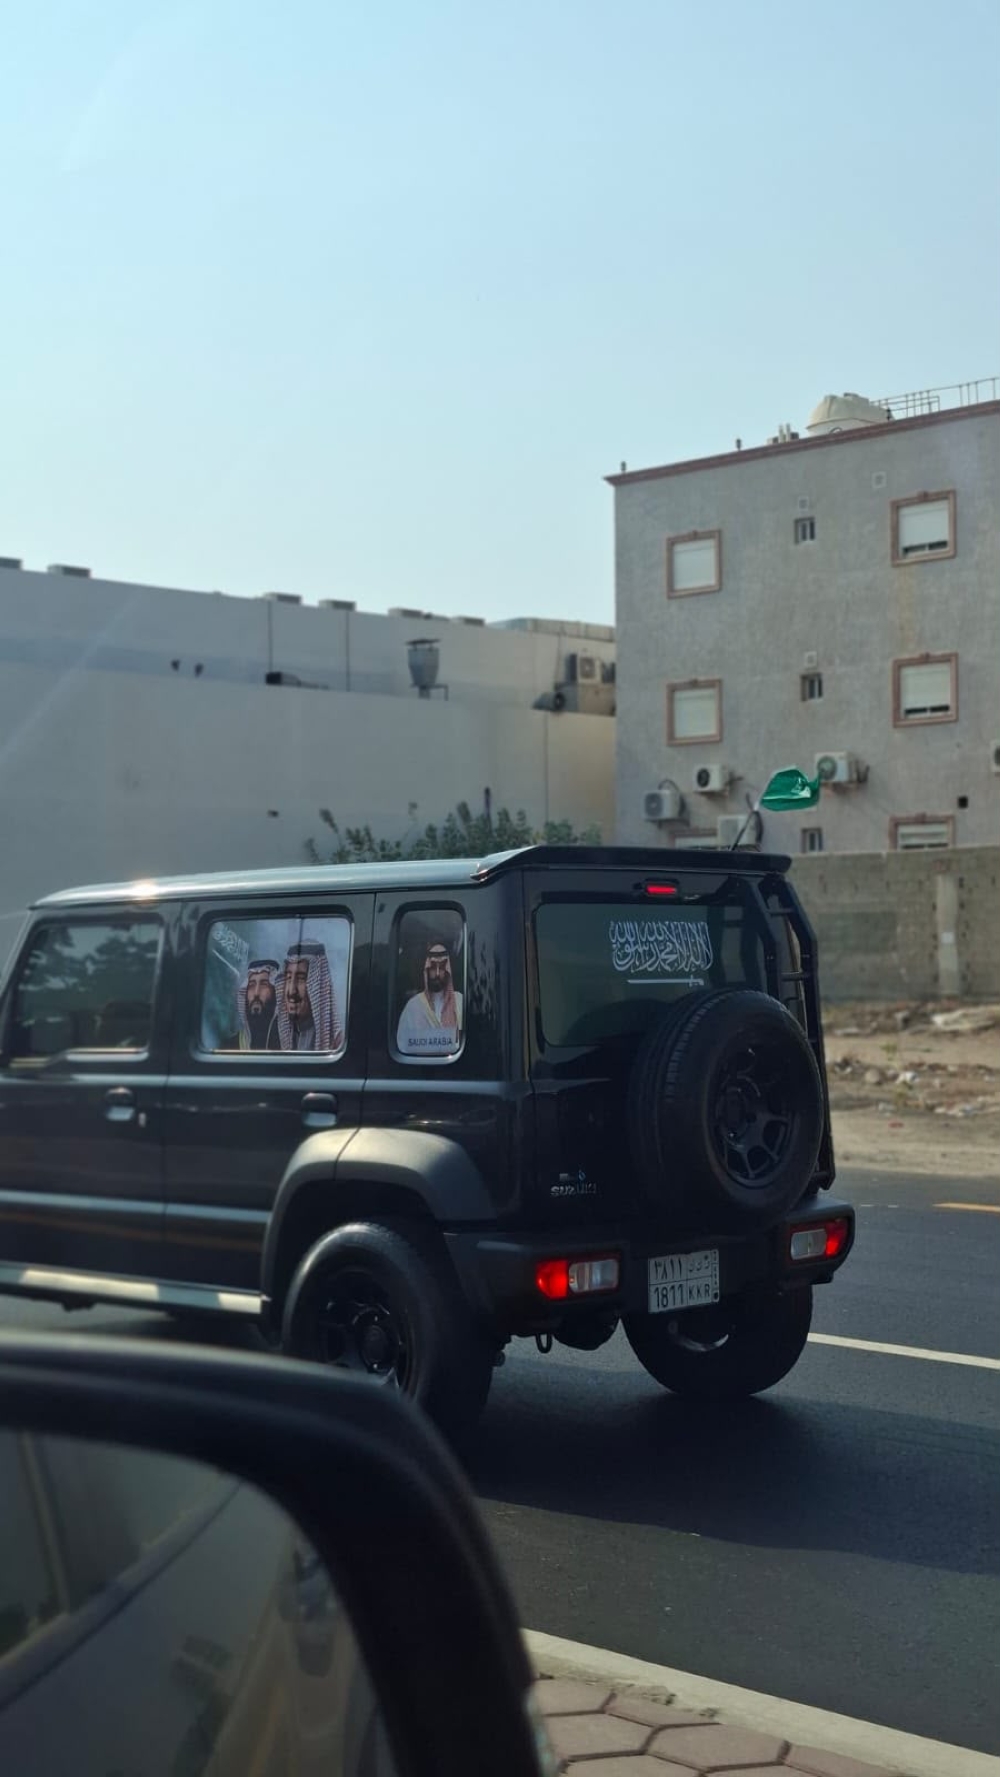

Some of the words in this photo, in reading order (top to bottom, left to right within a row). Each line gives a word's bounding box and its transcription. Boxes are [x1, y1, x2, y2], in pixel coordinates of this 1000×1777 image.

[408, 1038, 428, 1047] SAUDI
[429, 1036, 453, 1046] ARABIA
[654, 1283, 684, 1309] 1811
[688, 1283, 710, 1301] KKR
